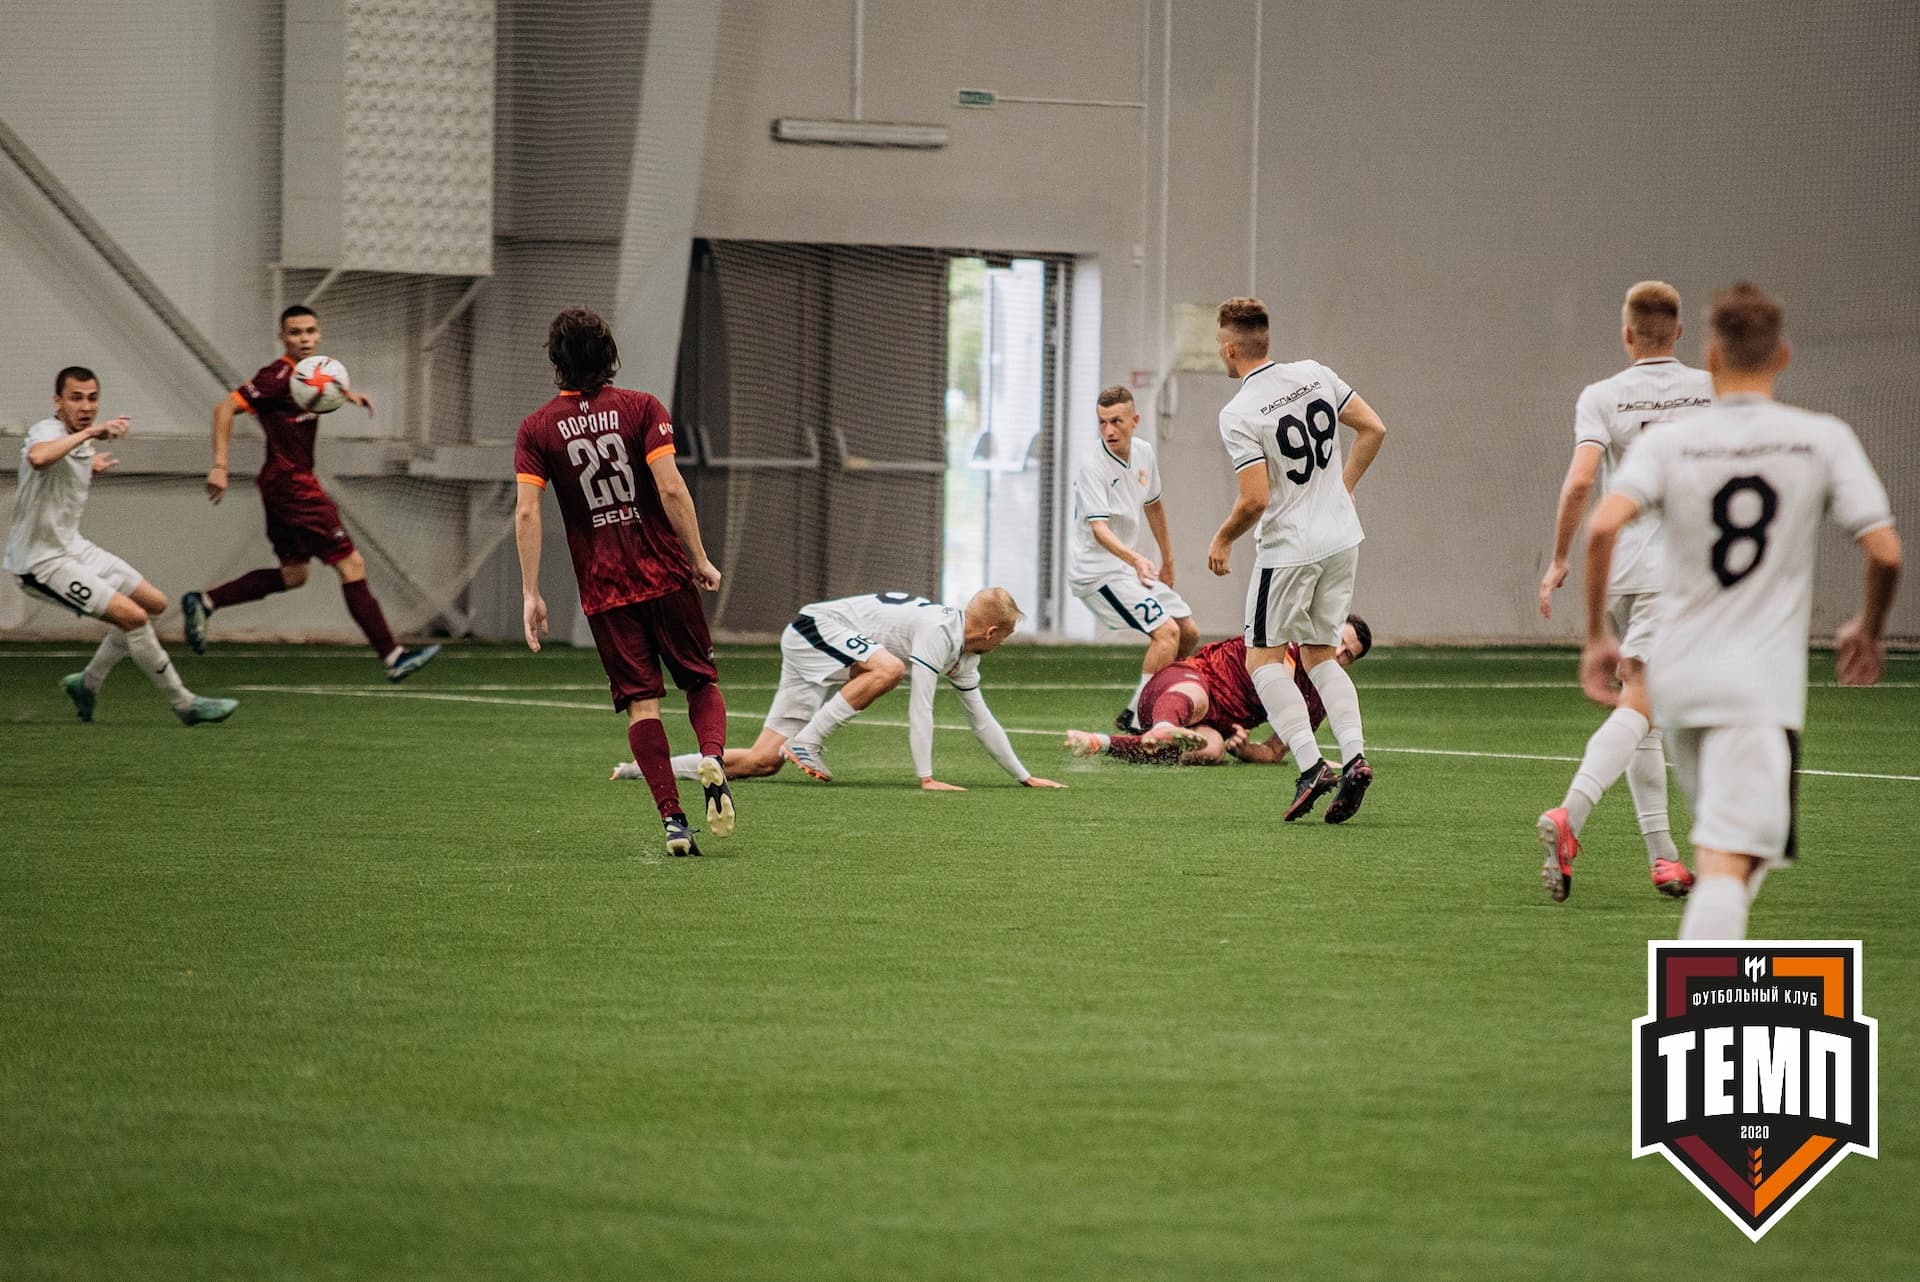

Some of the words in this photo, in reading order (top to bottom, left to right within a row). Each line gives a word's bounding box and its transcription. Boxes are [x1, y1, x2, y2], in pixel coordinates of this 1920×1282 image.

[557, 410, 620, 440] ВОРОНА
[1276, 398, 1336, 485] 98
[567, 433, 636, 511] 23
[1712, 475, 1779, 588] 8
[65, 581, 92, 606] 18
[1134, 597, 1164, 624] 23
